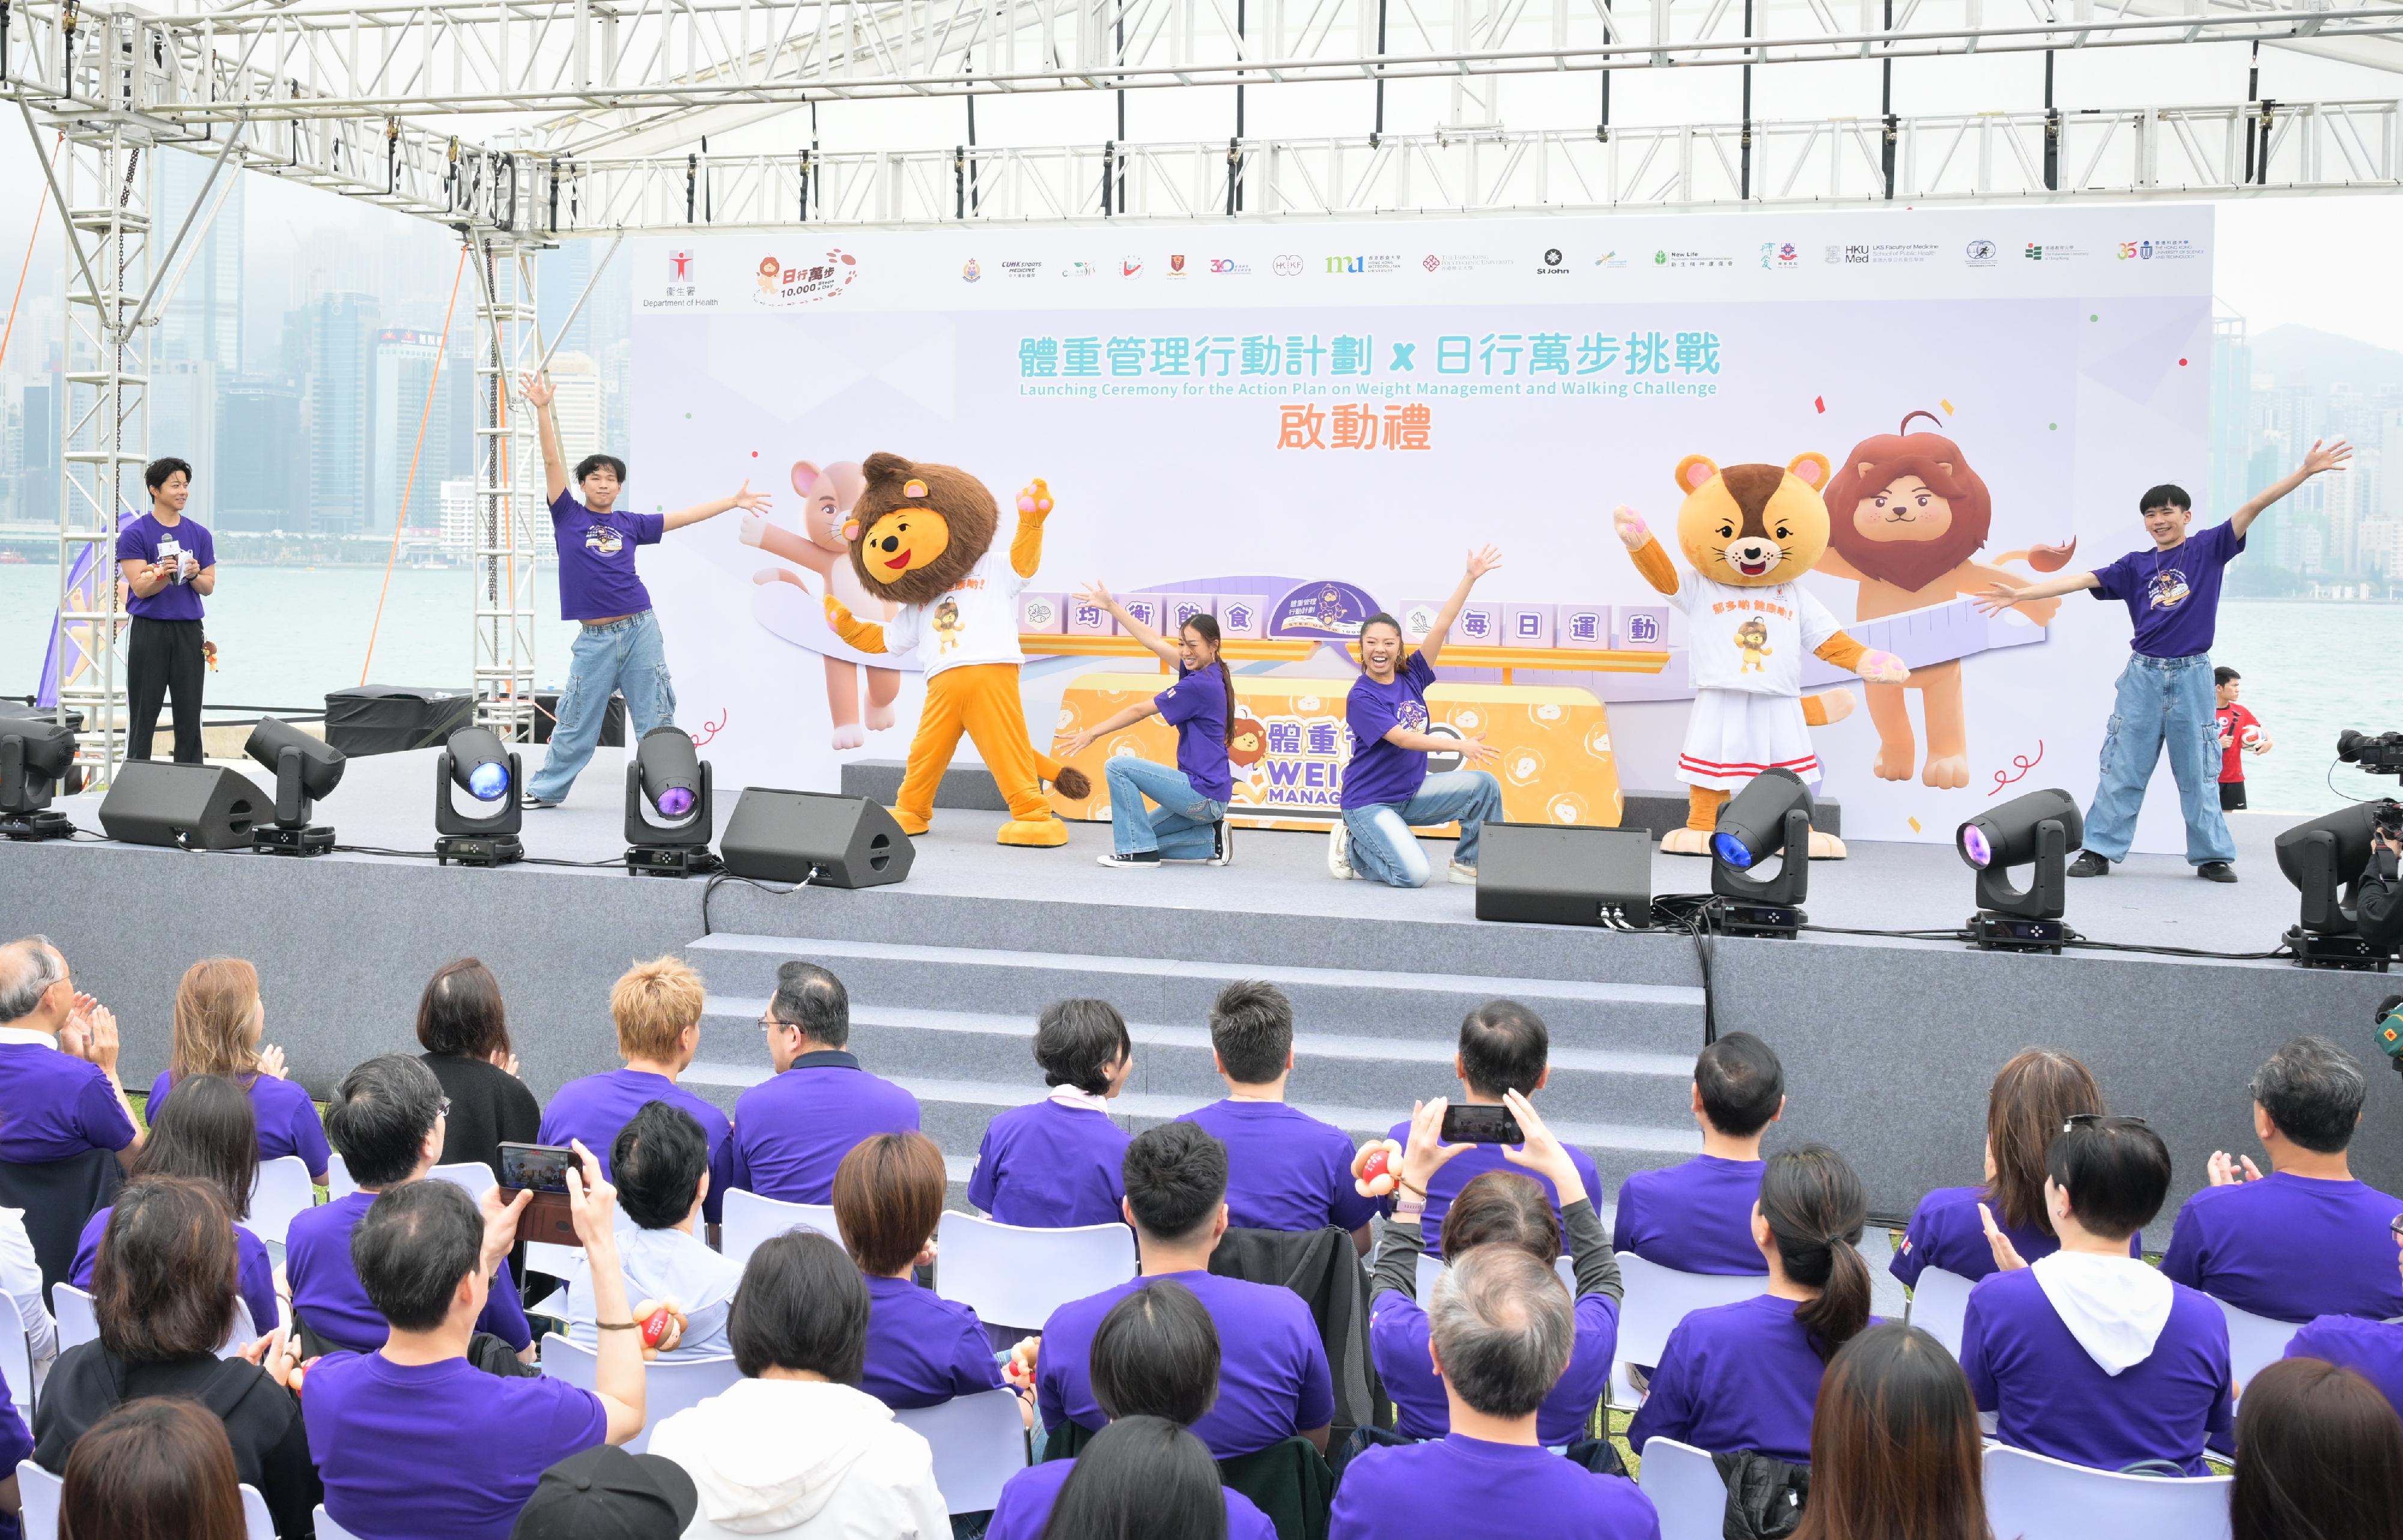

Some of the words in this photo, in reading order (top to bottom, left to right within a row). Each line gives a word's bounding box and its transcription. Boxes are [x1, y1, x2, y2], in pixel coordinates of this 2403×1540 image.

[1846, 244, 1869, 255] HKU
[1845, 255, 1869, 263] Med
[782, 265, 835, 285] 日行萬步
[643, 299, 685, 308] Department
[1019, 334, 1373, 377] 體重管理行動計劃
[1437, 332, 1721, 375] 日行萬步挑戰
[1020, 383, 1097, 398] Launching
[1102, 383, 1177, 398] Ceremony
[1183, 383, 1203, 395] for
[1209, 383, 1233, 395] the
[1238, 383, 1287, 395] Action
[1292, 383, 1326, 395] Plan
[1332, 385, 1351, 395] on
[1356, 382, 1411, 398] Weight
[1417, 383, 1521, 398] Management
[1527, 382, 1557, 395] and
[1562, 381, 1629, 398] Walking
[1633, 381, 1717, 398] Challenge
[1277, 403, 1431, 450] 啟動禮
[1290, 598, 1317, 608] 體重管理
